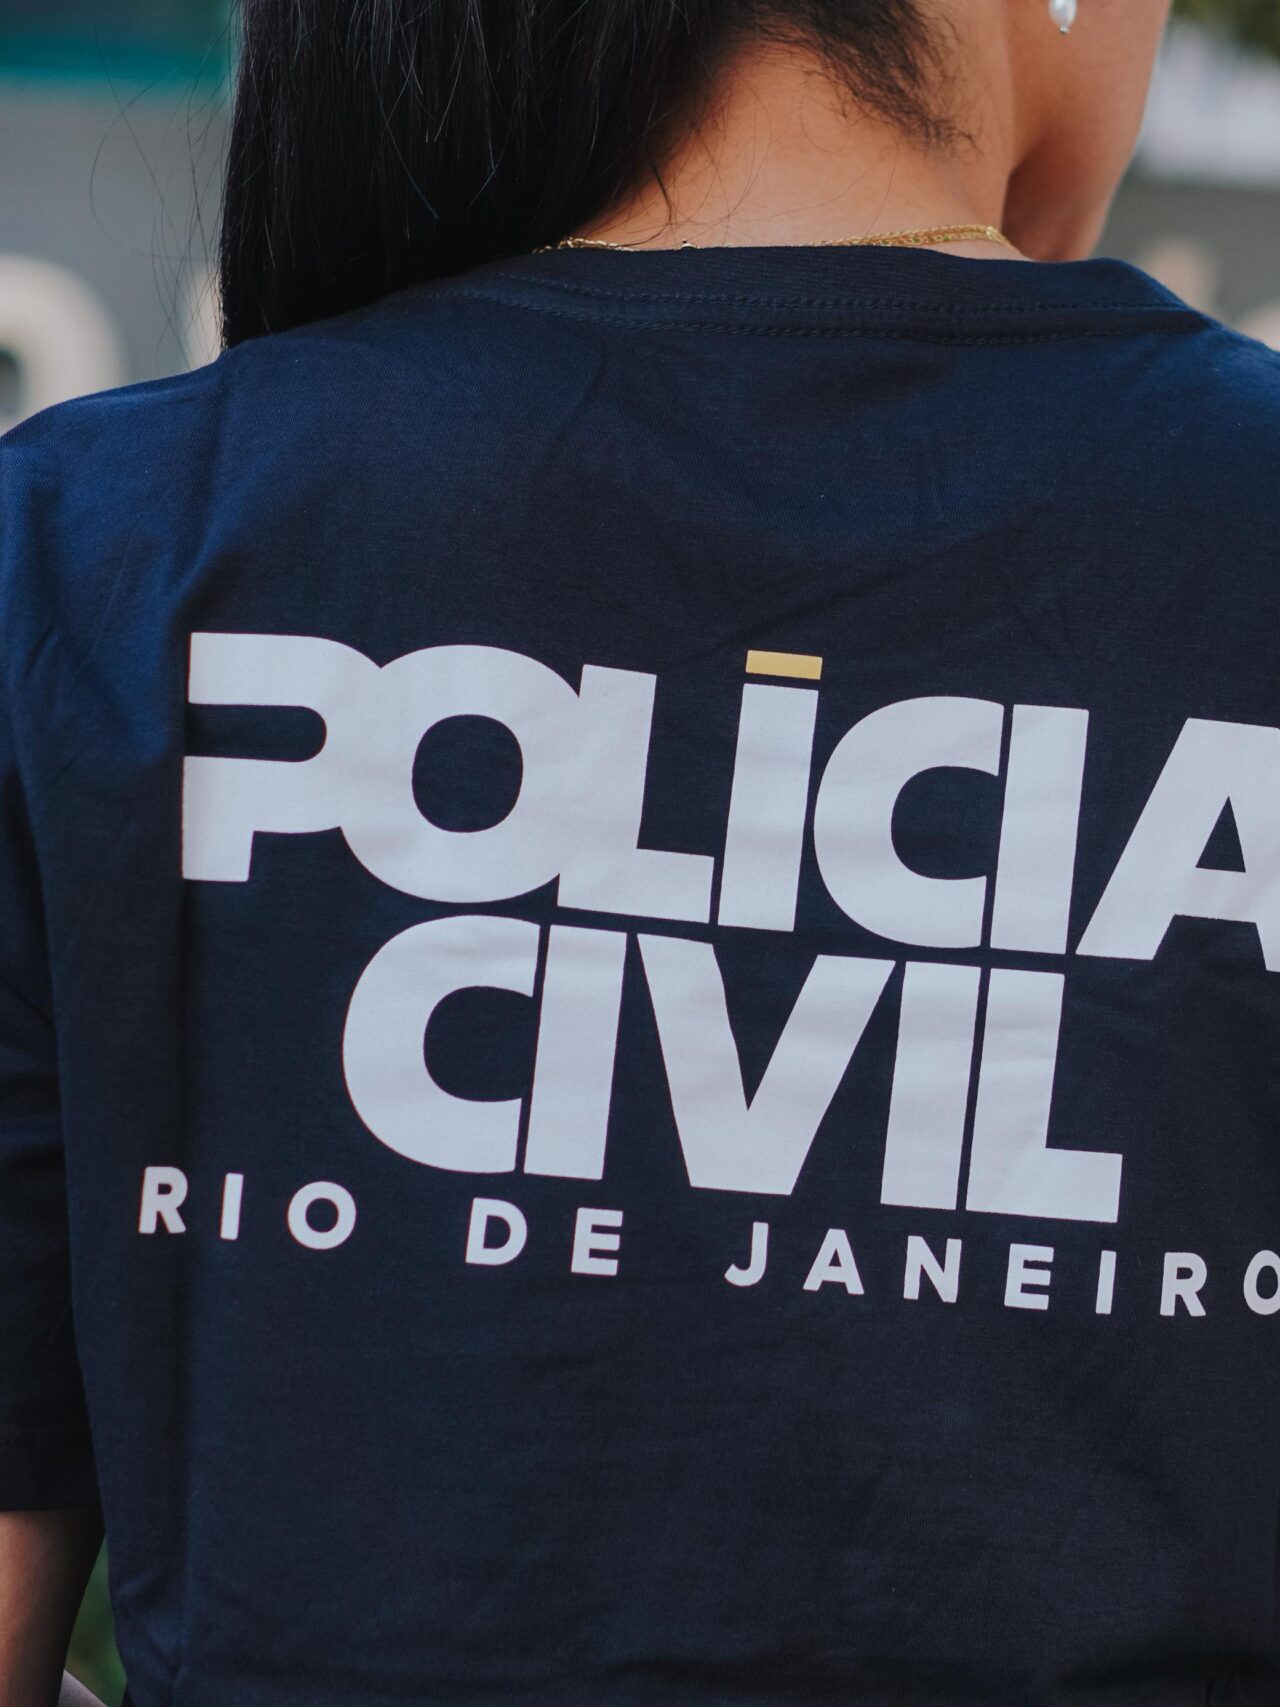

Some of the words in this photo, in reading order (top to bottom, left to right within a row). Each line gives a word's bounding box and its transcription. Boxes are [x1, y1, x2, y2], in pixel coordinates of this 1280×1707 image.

[342, 914, 1124, 1224] CIVIL
[138, 1166, 358, 1251] RIO
[465, 1197, 625, 1277] DE
